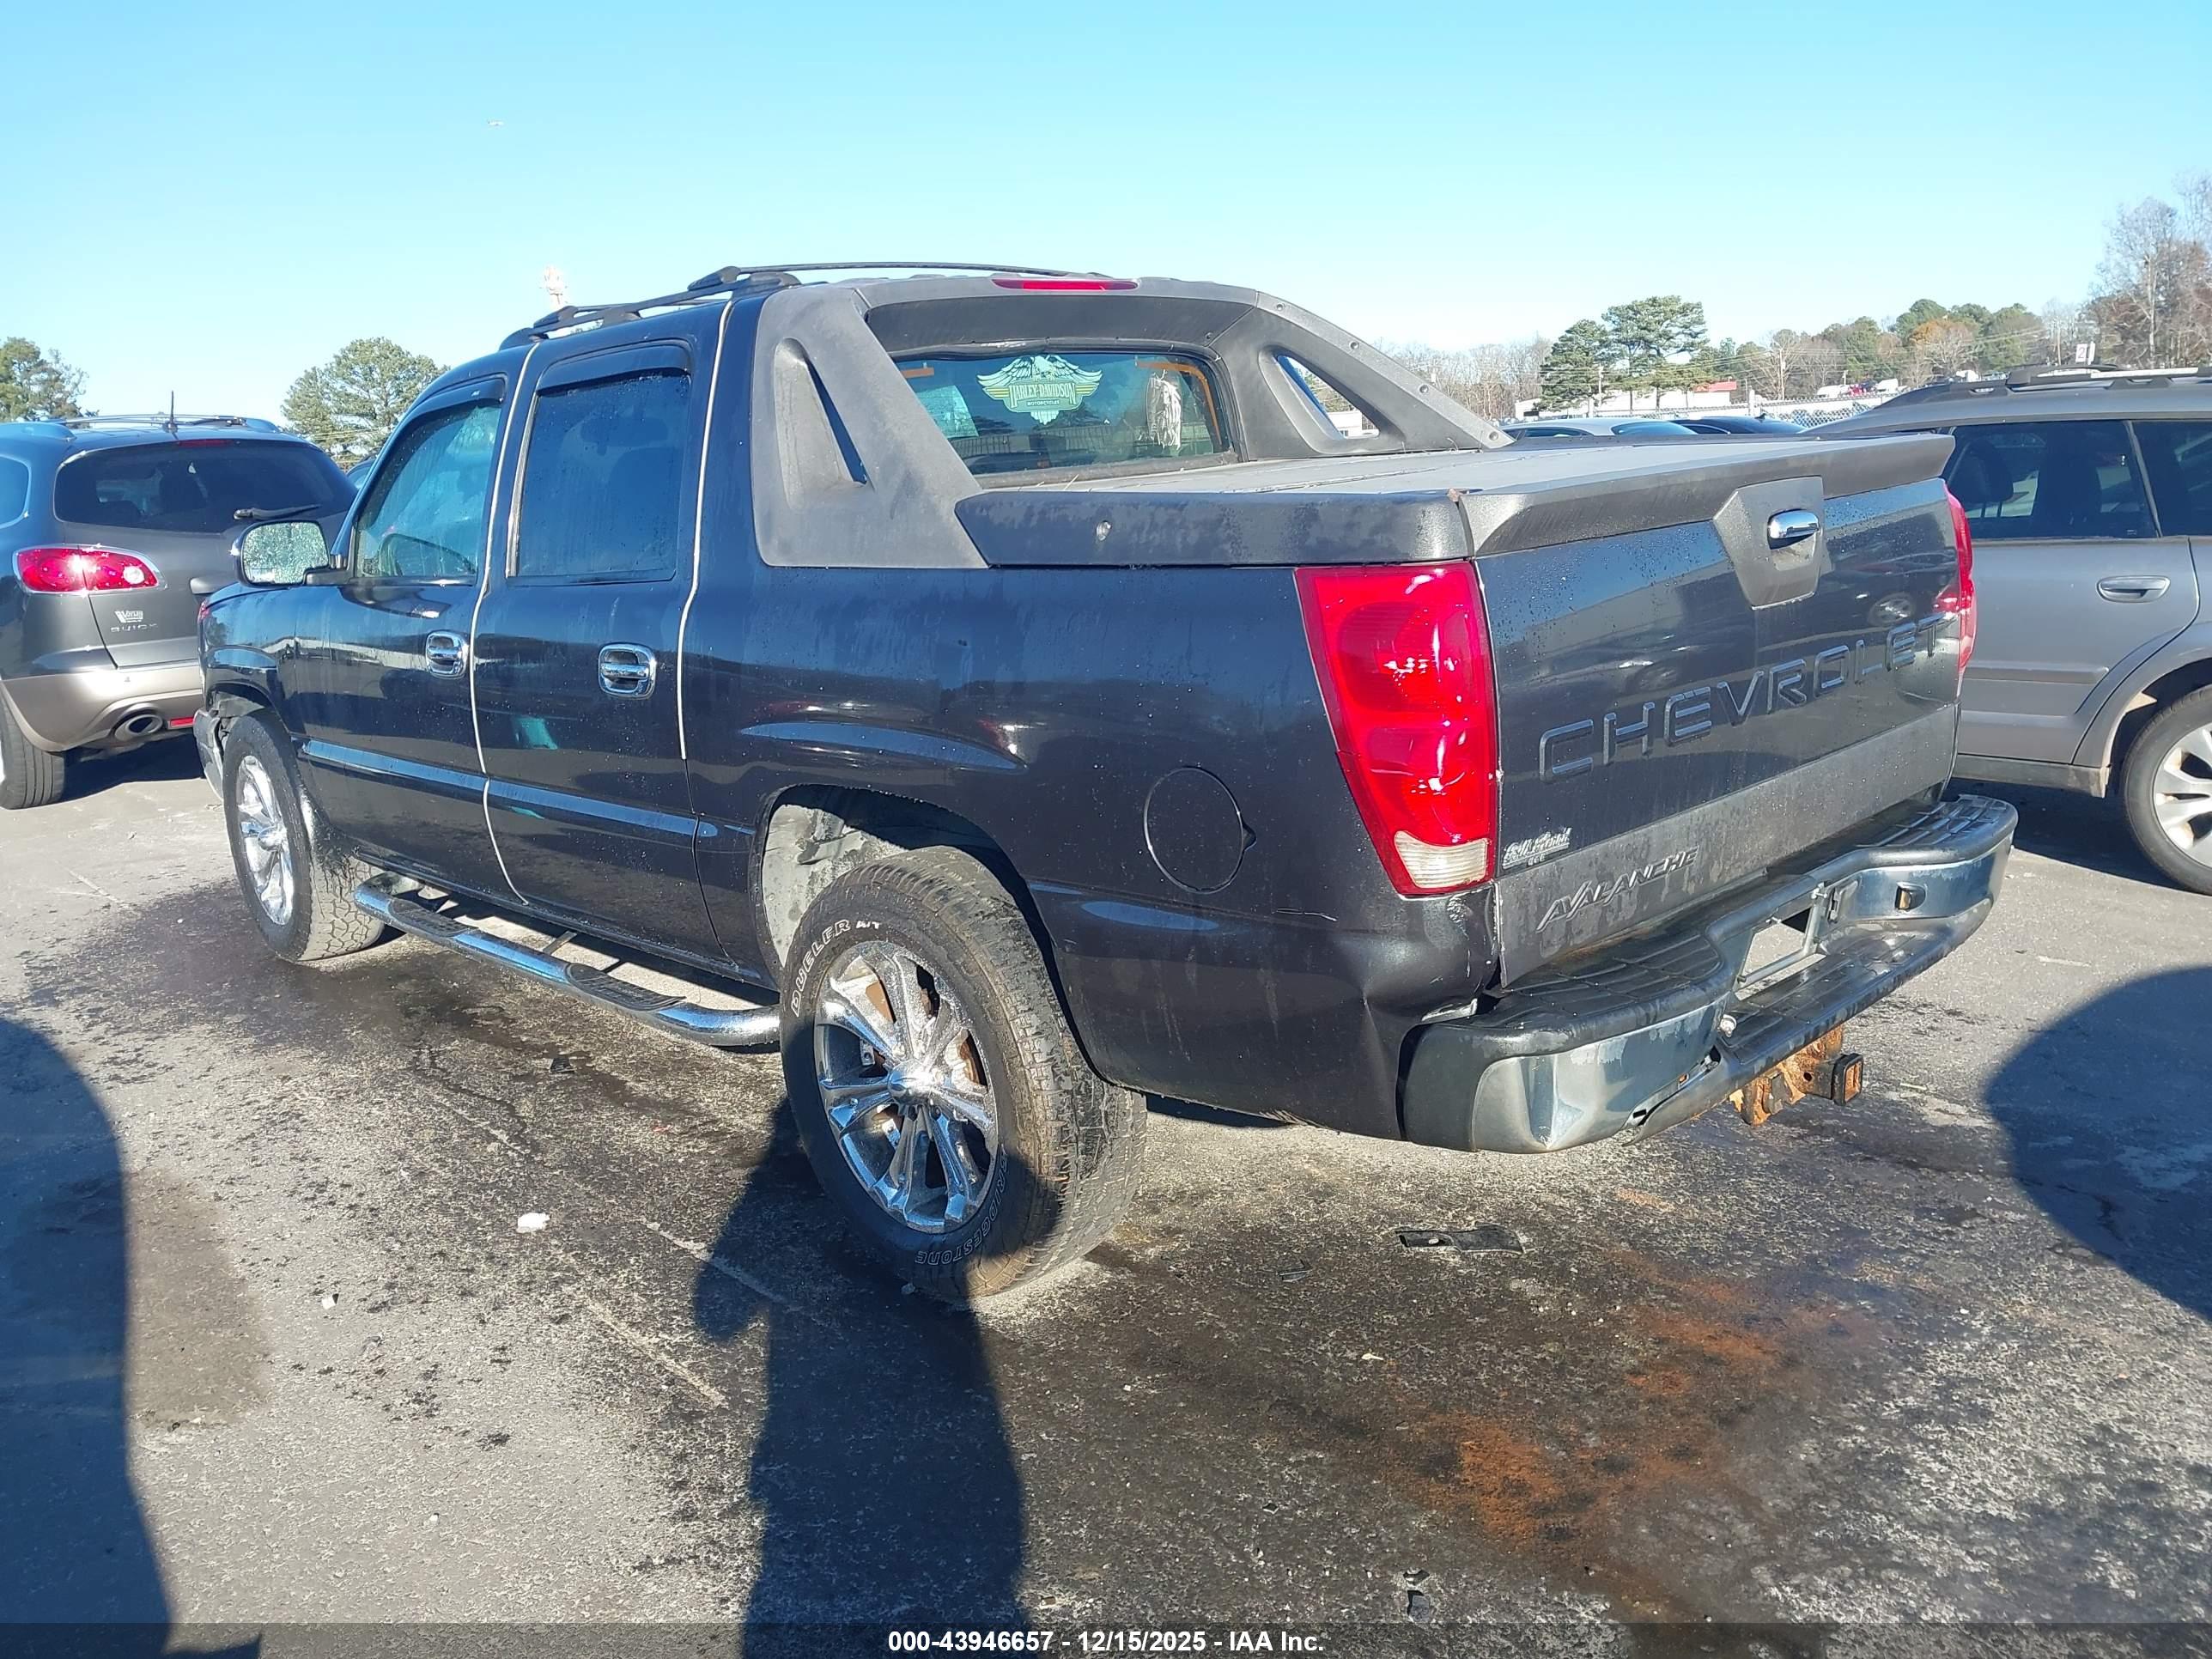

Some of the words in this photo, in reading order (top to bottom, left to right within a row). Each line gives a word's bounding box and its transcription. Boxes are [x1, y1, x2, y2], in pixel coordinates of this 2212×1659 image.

[1009, 382, 1076, 408] HARLEY-DAVIDSON
[1539, 613, 1954, 779] CHEVROLET
[1536, 845, 1699, 933] AVALANCHE
[791, 919, 851, 1018] DUELER
[914, 1143, 1009, 1267] BRIDGESTONE
